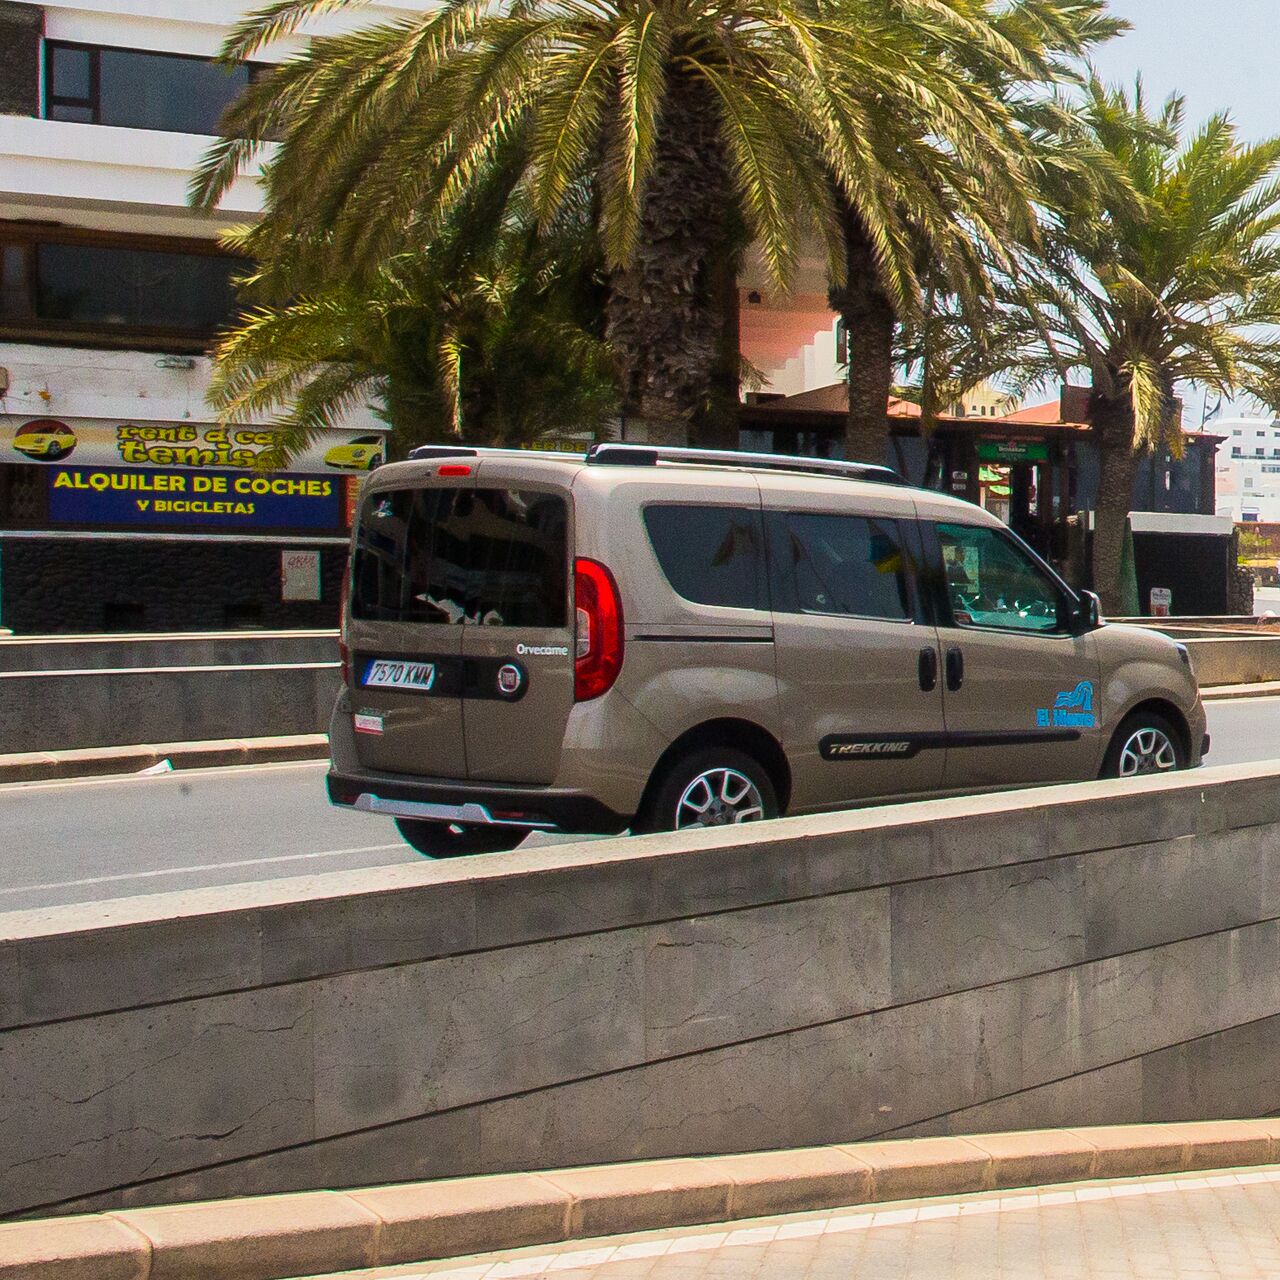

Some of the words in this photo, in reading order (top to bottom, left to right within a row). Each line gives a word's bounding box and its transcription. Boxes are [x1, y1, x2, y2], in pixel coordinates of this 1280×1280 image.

[116, 425, 196, 444] rent
[54, 472, 186, 492] ALQUILER
[193, 476, 227, 493] DE
[234, 477, 332, 497] COCHES
[136, 500, 149, 511] Y
[154, 500, 255, 514] BICICLETAS
[371, 663, 404, 682] 7570
[829, 741, 911, 755] TREKKING
